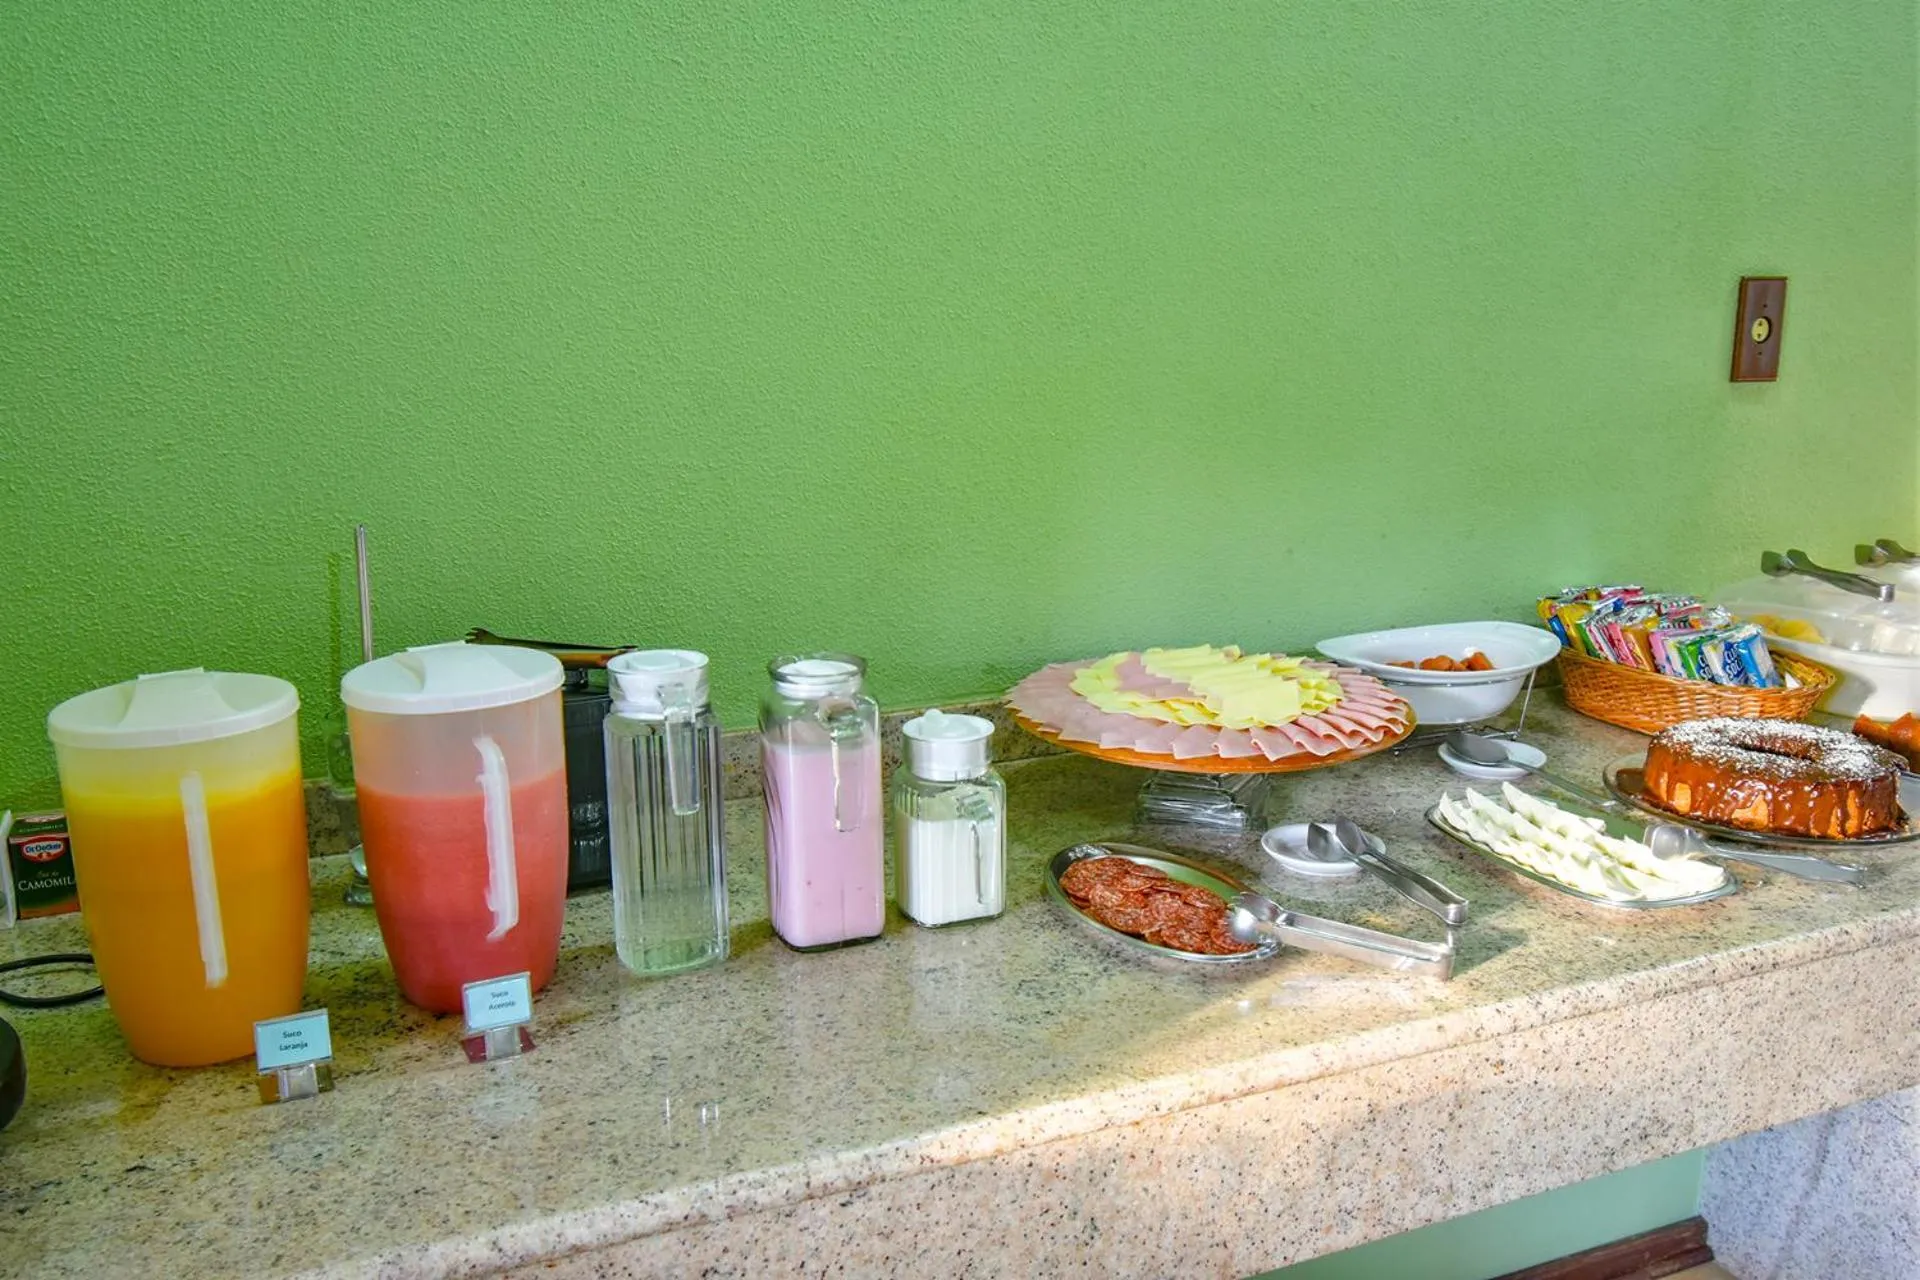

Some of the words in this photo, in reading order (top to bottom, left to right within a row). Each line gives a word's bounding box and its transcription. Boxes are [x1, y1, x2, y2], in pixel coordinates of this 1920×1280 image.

[18, 876, 76, 891] CAMOMIL
[282, 1030, 302, 1039] Suco
[279, 1042, 308, 1052] Laranja
